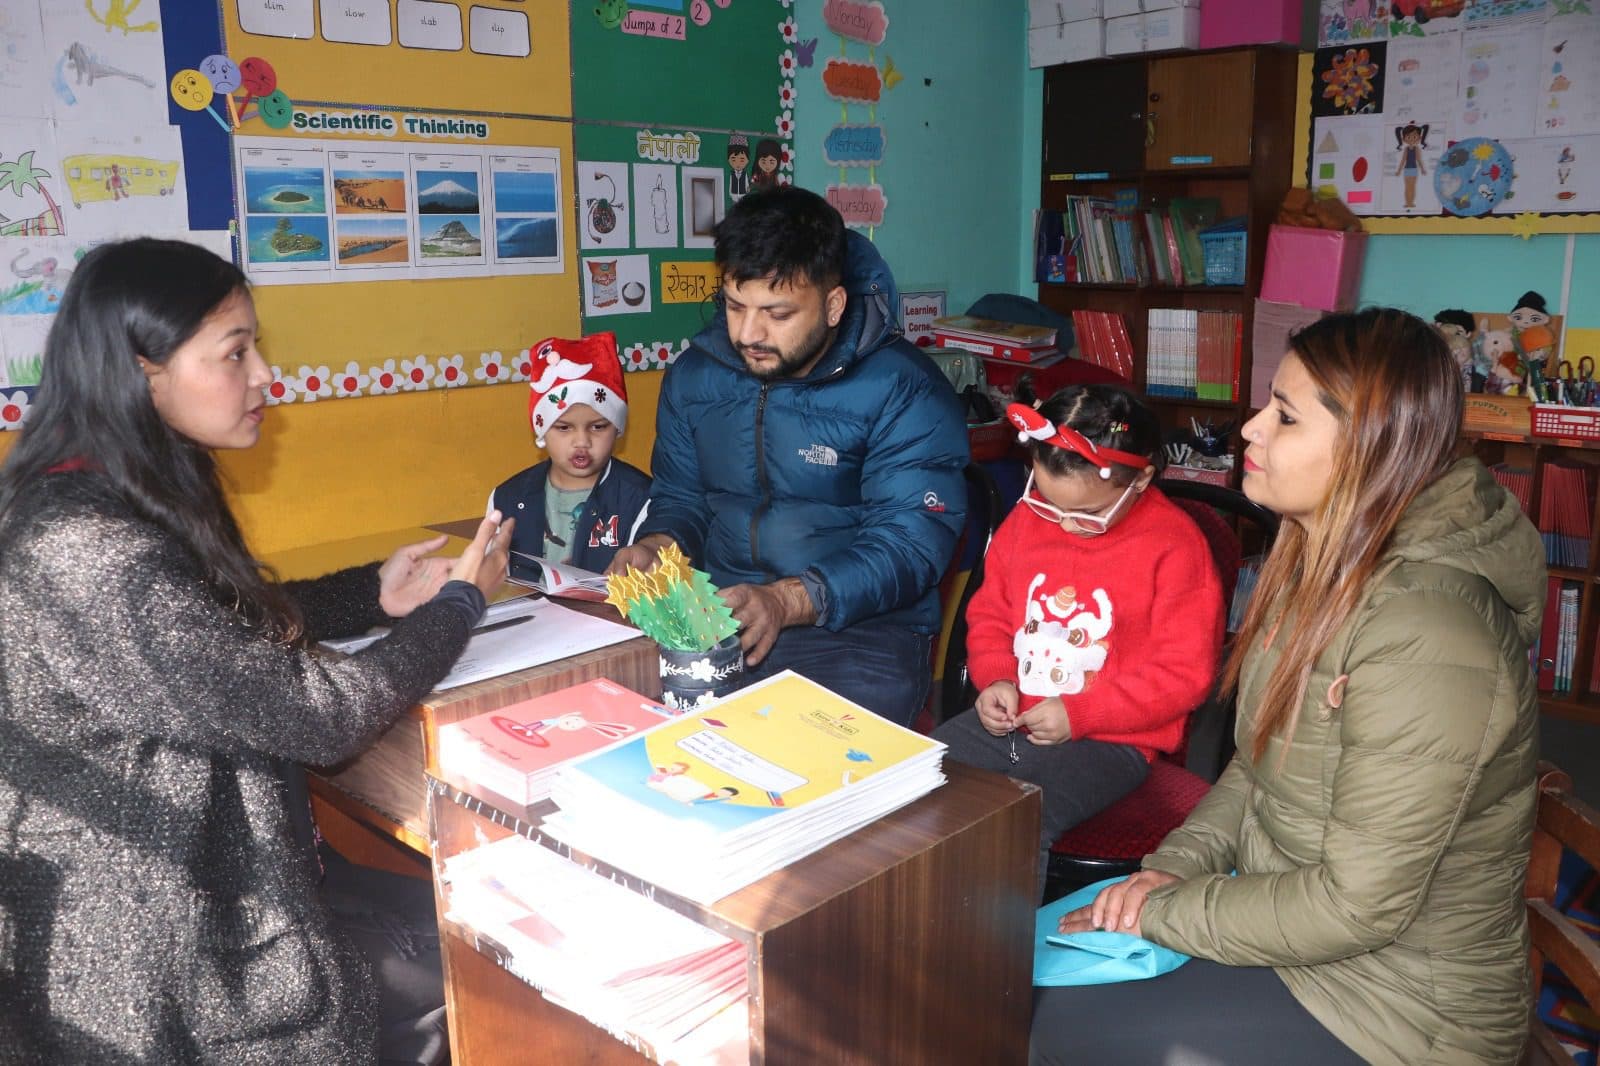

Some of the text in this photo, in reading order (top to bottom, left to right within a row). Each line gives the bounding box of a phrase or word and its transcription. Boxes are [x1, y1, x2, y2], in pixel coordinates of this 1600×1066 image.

[264, 0, 285, 11] slim
[345, 7, 366, 18] slow
[694, 3, 704, 21] 2
[420, 15, 438, 27] slab
[624, 11, 683, 36] Jumps of 2
[491, 23, 505, 36] slip
[293, 112, 487, 138] Scientific Thinking
[638, 131, 700, 159] नेपाली
[828, 189, 876, 221] Thursday
[905, 304, 938, 317] Learning
[908, 322, 933, 332] Corne
[798, 448, 825, 458] NORTH
[810, 443, 825, 452] THE
[805, 456, 825, 464] FACE
